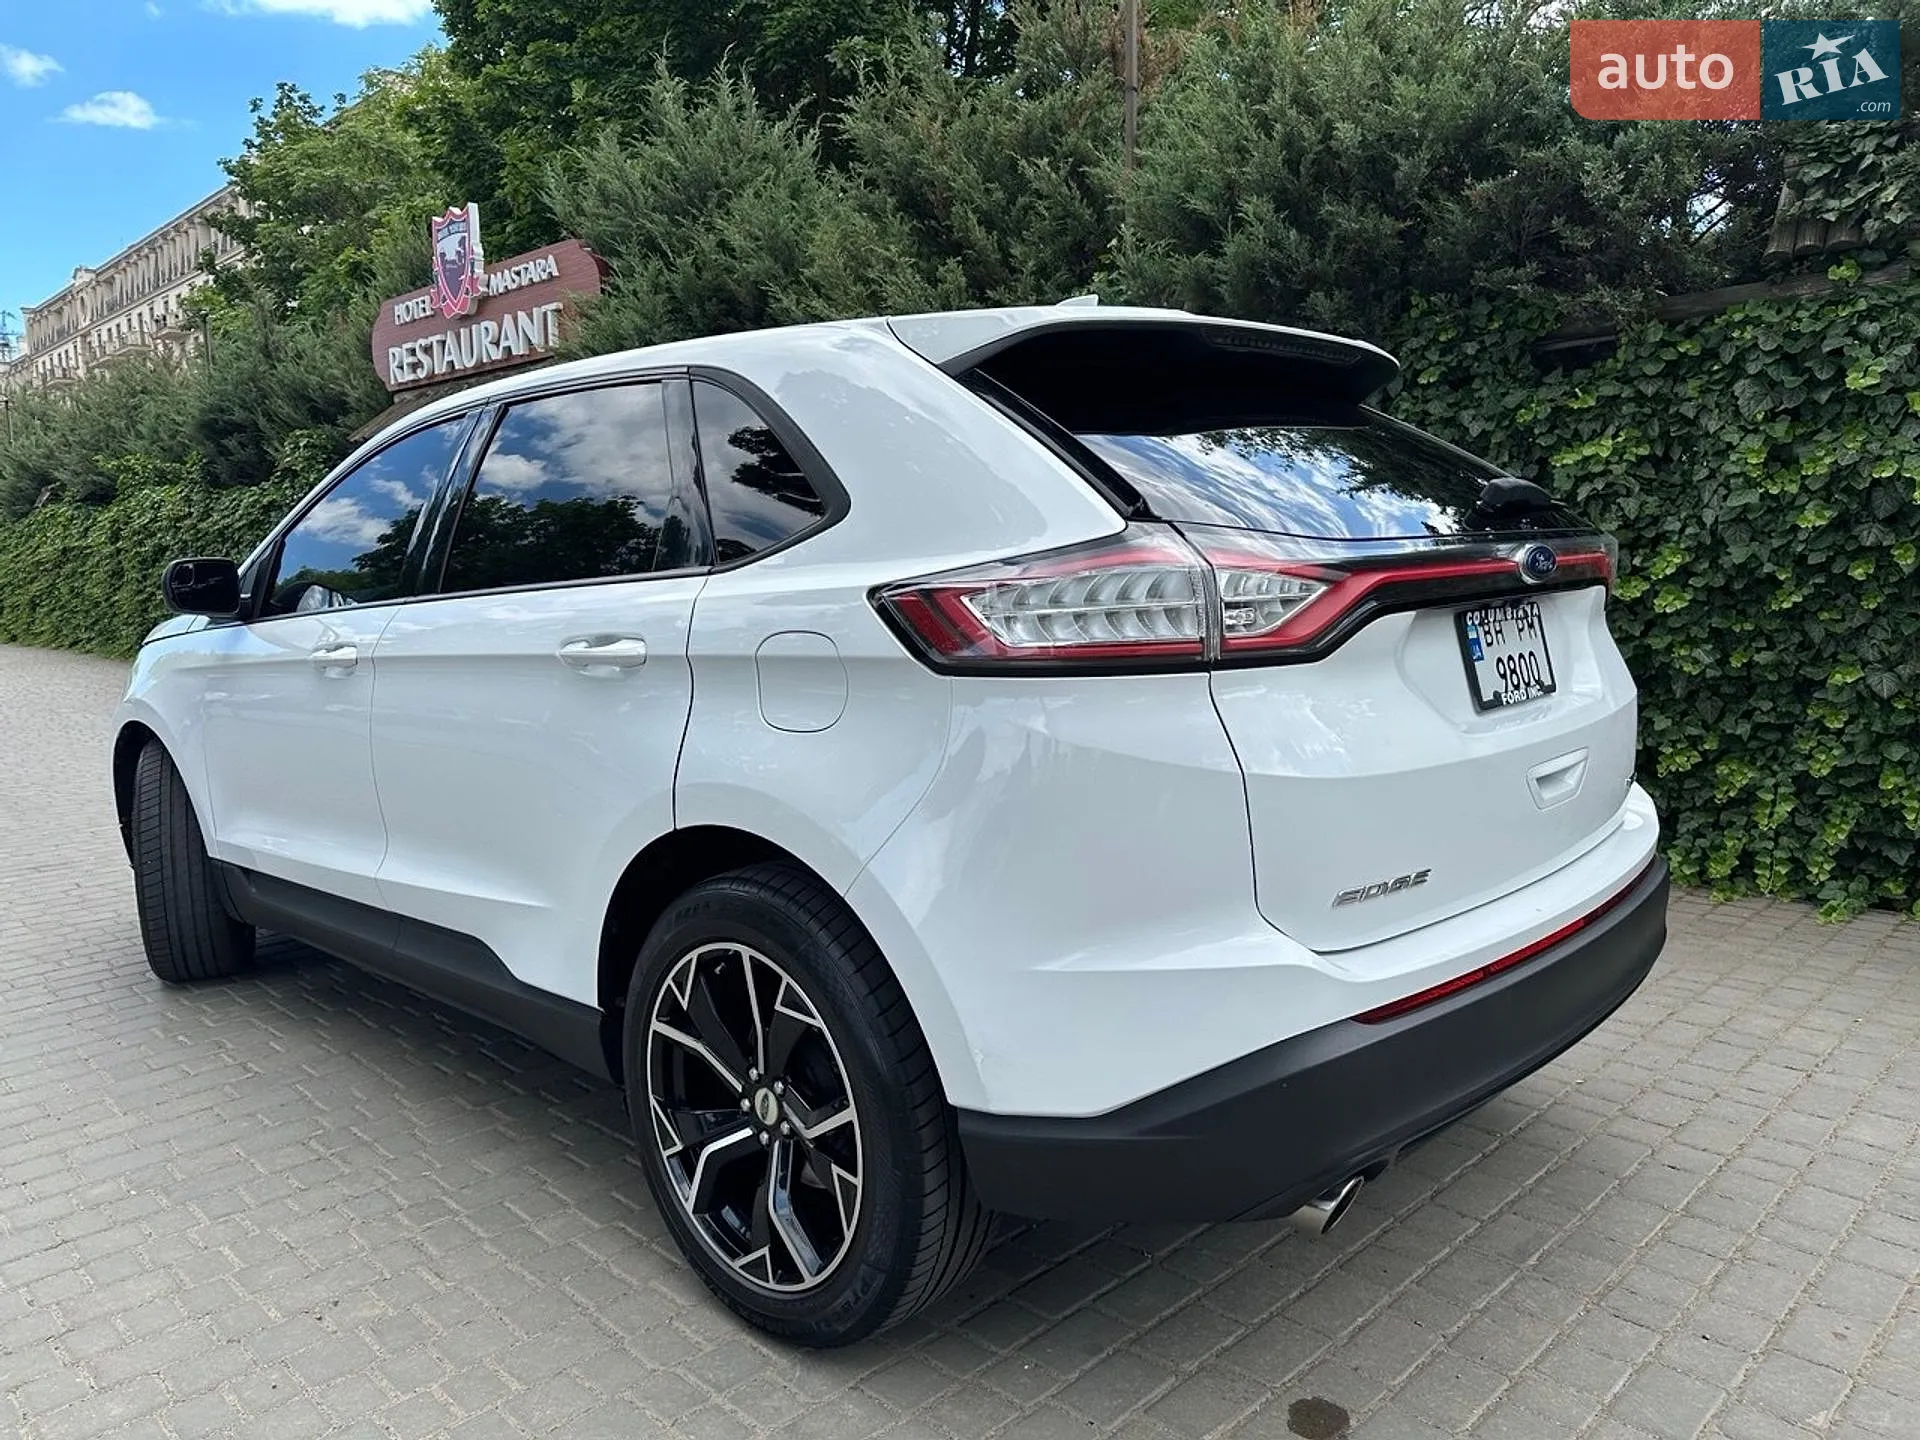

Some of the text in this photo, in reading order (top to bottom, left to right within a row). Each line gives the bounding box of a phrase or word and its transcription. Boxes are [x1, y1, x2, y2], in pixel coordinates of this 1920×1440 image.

[394, 254, 560, 326] HOTEL MASTARA
[388, 302, 563, 385] RESTAURANT
[1496, 650, 1542, 693] 9800
[1501, 688, 1526, 705] FORD
[1331, 868, 1432, 909] EDGE
